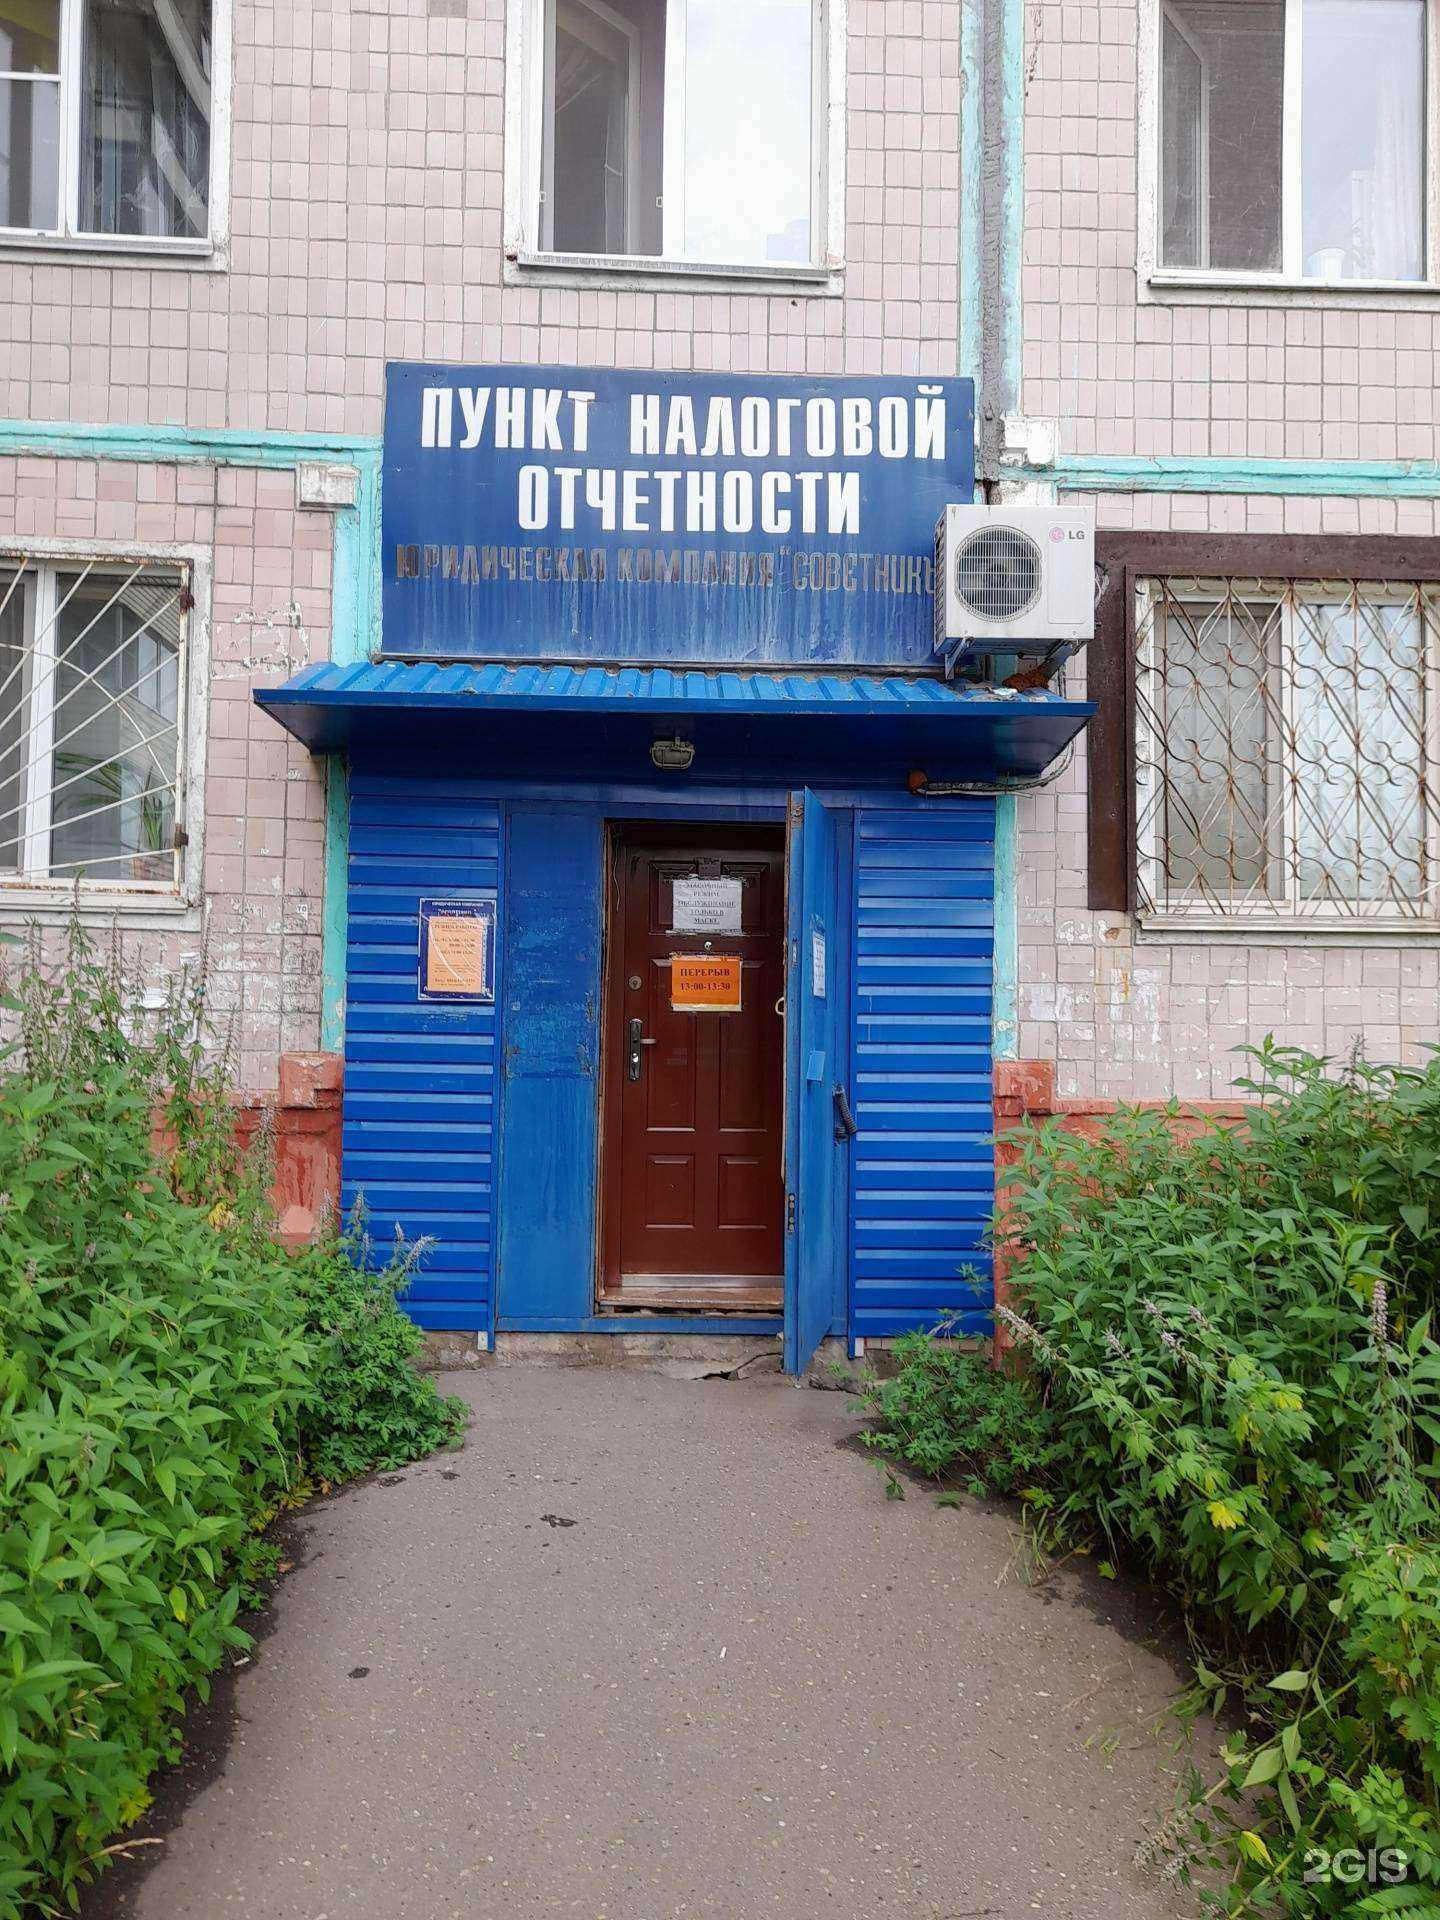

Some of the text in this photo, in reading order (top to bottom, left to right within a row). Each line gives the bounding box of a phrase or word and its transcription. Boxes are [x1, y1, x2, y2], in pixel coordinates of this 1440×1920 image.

[421, 385, 946, 460] ПУНКТ НАЛОГОВОЙ
[518, 465, 860, 535] ОТЧЕТНОСТИ
[1068, 530, 1085, 540] LG
[396, 544, 607, 584] ЮРИДИЧЕСКАЯ
[617, 548, 774, 587] КОМПАНИЯ
[680, 968, 730, 977] ПЕРЕРЫВ
[680, 982, 731, 991] 13:00-13:30
